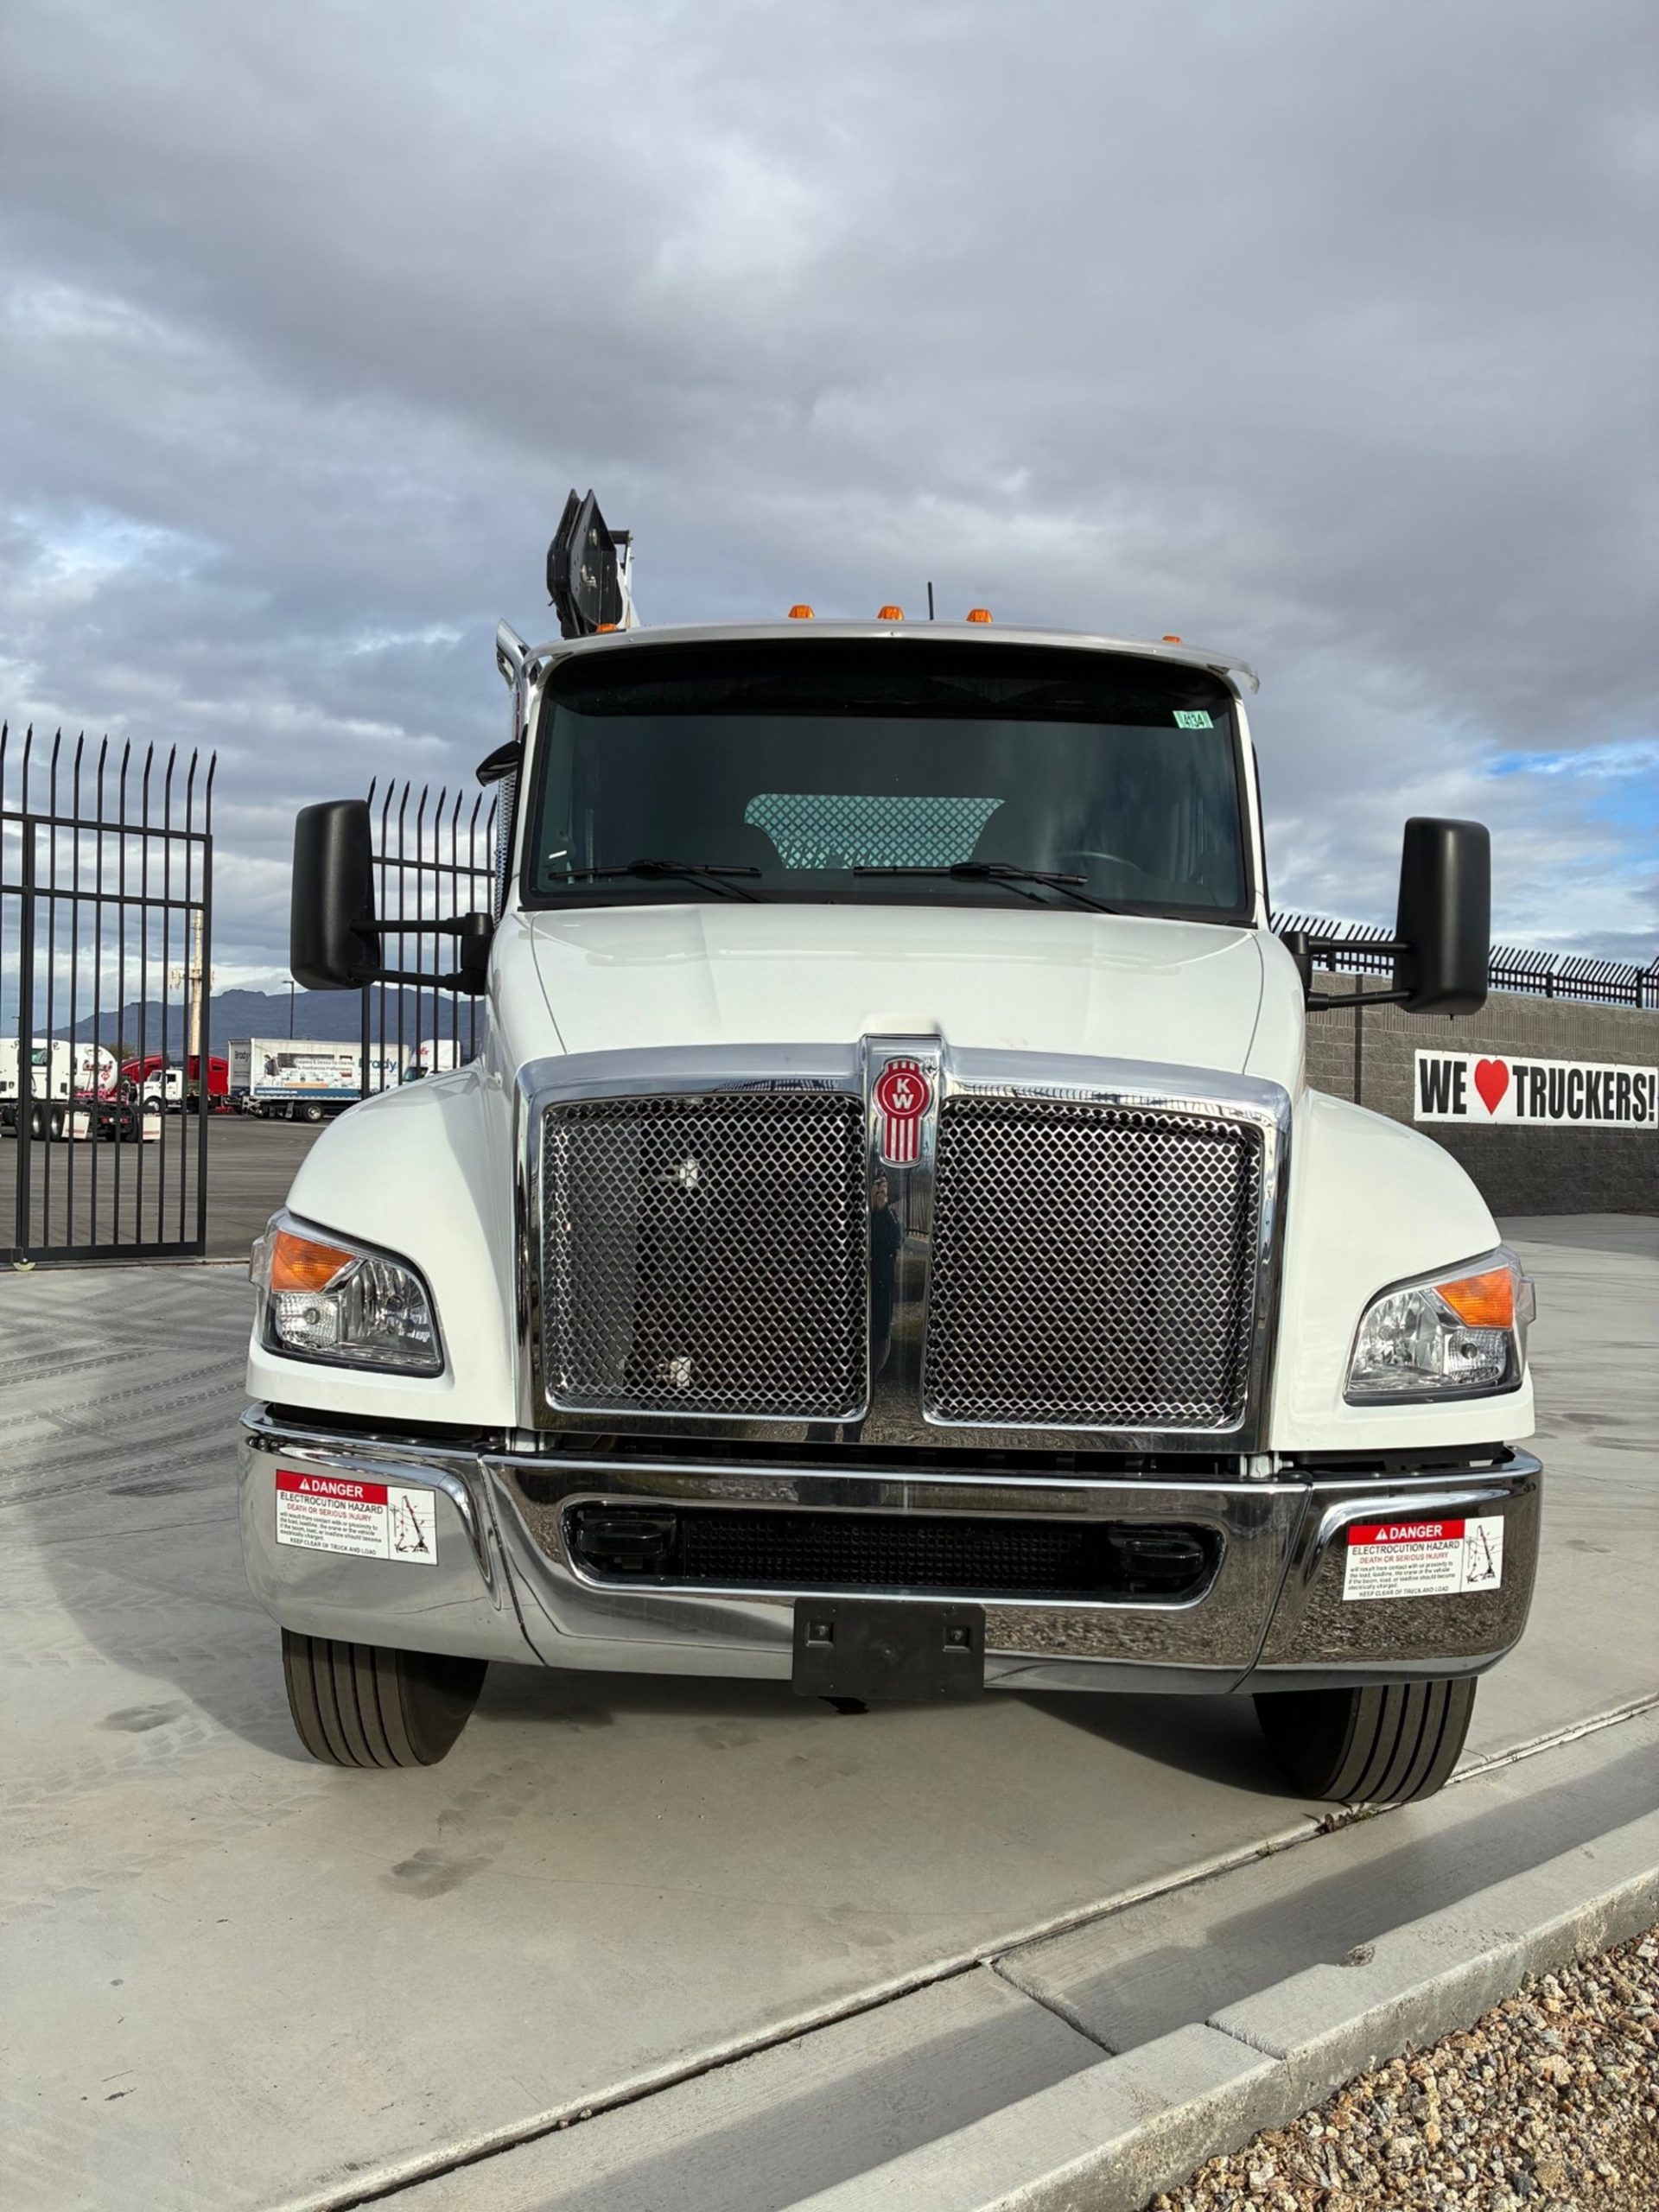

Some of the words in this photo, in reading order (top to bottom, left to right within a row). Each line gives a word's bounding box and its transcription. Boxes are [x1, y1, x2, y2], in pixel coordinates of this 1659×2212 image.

[359, 1058, 397, 1072] rady
[897, 1077, 911, 1094] K
[1419, 1058, 1467, 1115] WE
[1512, 1065, 1656, 1122] TRUCKERS!
[893, 1094, 914, 1109] W
[311, 1480, 364, 1498] DANGER
[280, 1492, 345, 1509] ELECTROCUTION
[347, 1502, 382, 1514] HAZARD
[287, 1503, 306, 1512] DEATH
[319, 1508, 346, 1518] SERIOUS
[348, 1512, 371, 1522] INJURY
[1389, 1524, 1443, 1540] DANGER
[1351, 1543, 1424, 1555] ELECTROCUTION
[1426, 1541, 1459, 1550] HAZARD
